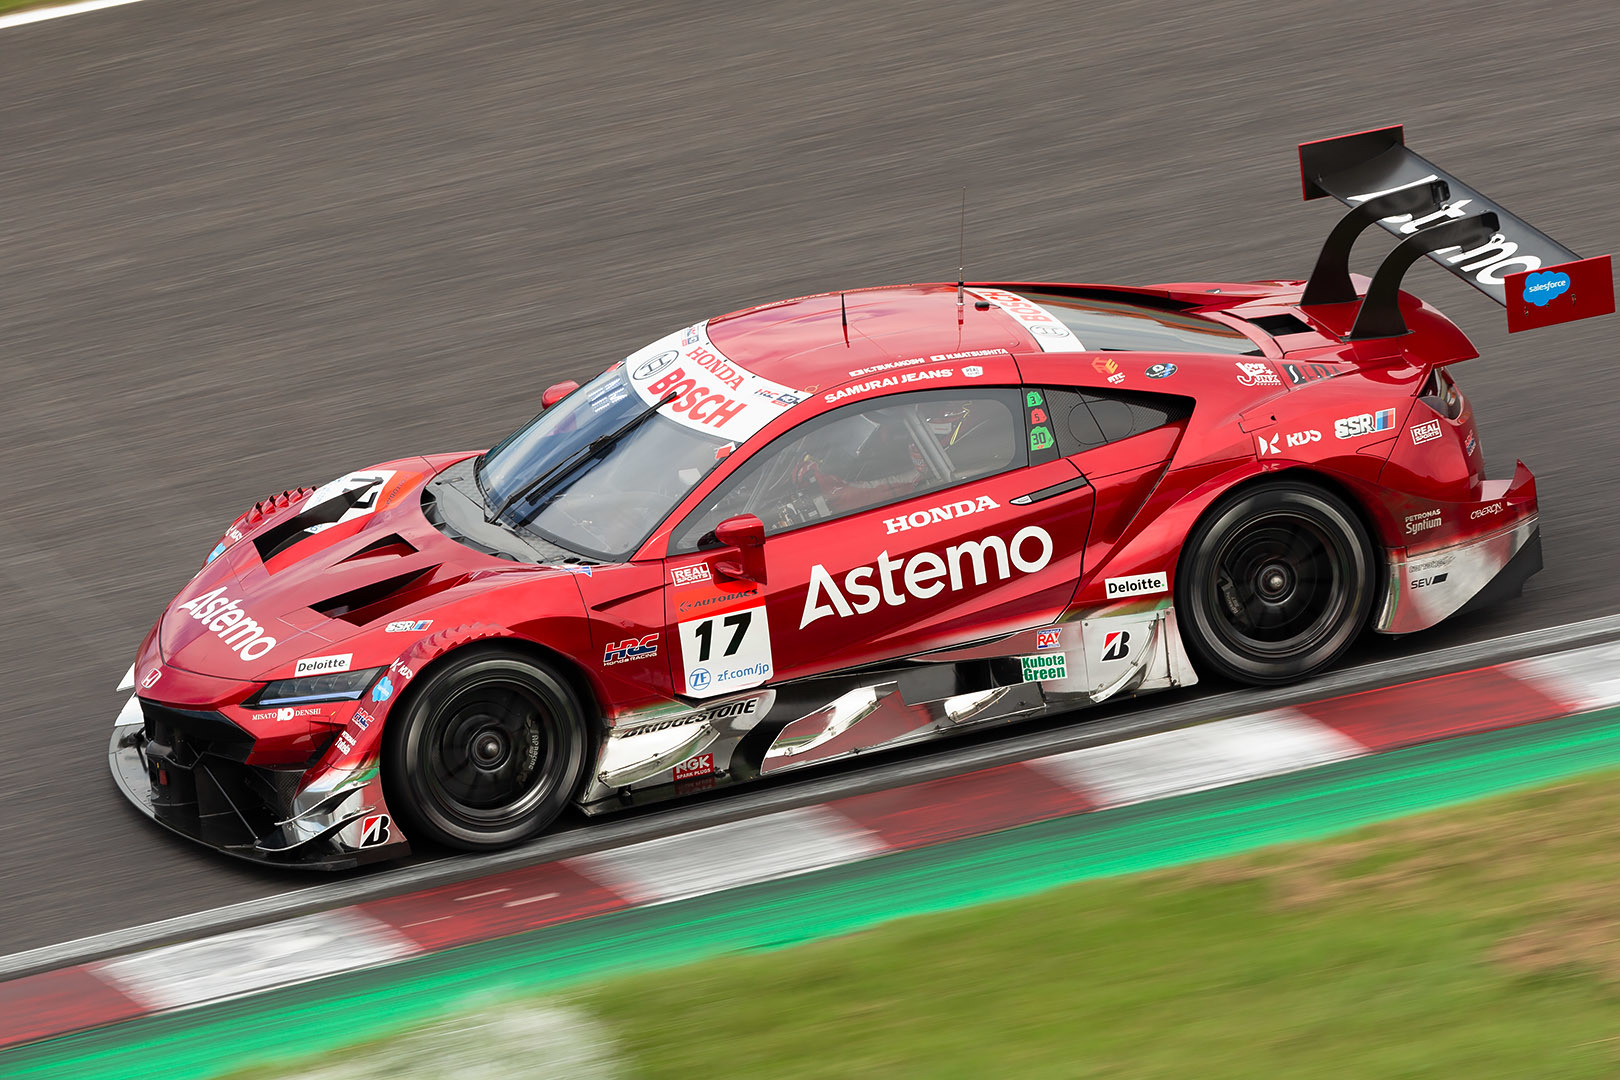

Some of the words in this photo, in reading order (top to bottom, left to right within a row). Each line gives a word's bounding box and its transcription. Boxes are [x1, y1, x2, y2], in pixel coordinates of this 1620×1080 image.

[1528, 278, 1566, 294] salesforce
[686, 346, 745, 391] HONDA
[824, 377, 899, 404] SAMURAI
[901, 369, 951, 384] JEANS
[648, 367, 747, 429] BOSCH
[1030, 395, 1036, 405] 3
[1034, 413, 1041, 422] 5
[1335, 414, 1376, 439] SSR
[1414, 423, 1439, 437] REAL
[1032, 432, 1047, 446] 30
[882, 495, 1001, 535] HONDA
[1405, 508, 1441, 522] PETRONAS
[1405, 517, 1442, 535] Syntium
[675, 566, 707, 579] REAL
[676, 573, 709, 584] SPORTS
[799, 525, 1053, 631] Astemo
[1410, 577, 1433, 590] SEV
[694, 588, 758, 608] AUTOBACS
[177, 586, 279, 662] Astemo
[695, 611, 752, 662] 17
[604, 632, 660, 662] HRC
[1022, 655, 1065, 668] Kubota
[691, 672, 711, 687] ZF
[717, 663, 770, 682] zf.com/jp
[1023, 666, 1066, 681] Green
[252, 711, 277, 720] MISATO
[295, 708, 321, 717] DENSHI
[620, 698, 757, 740] BRIDGESTONE
[676, 755, 710, 774] NGK
[676, 771, 694, 779] SPARK
